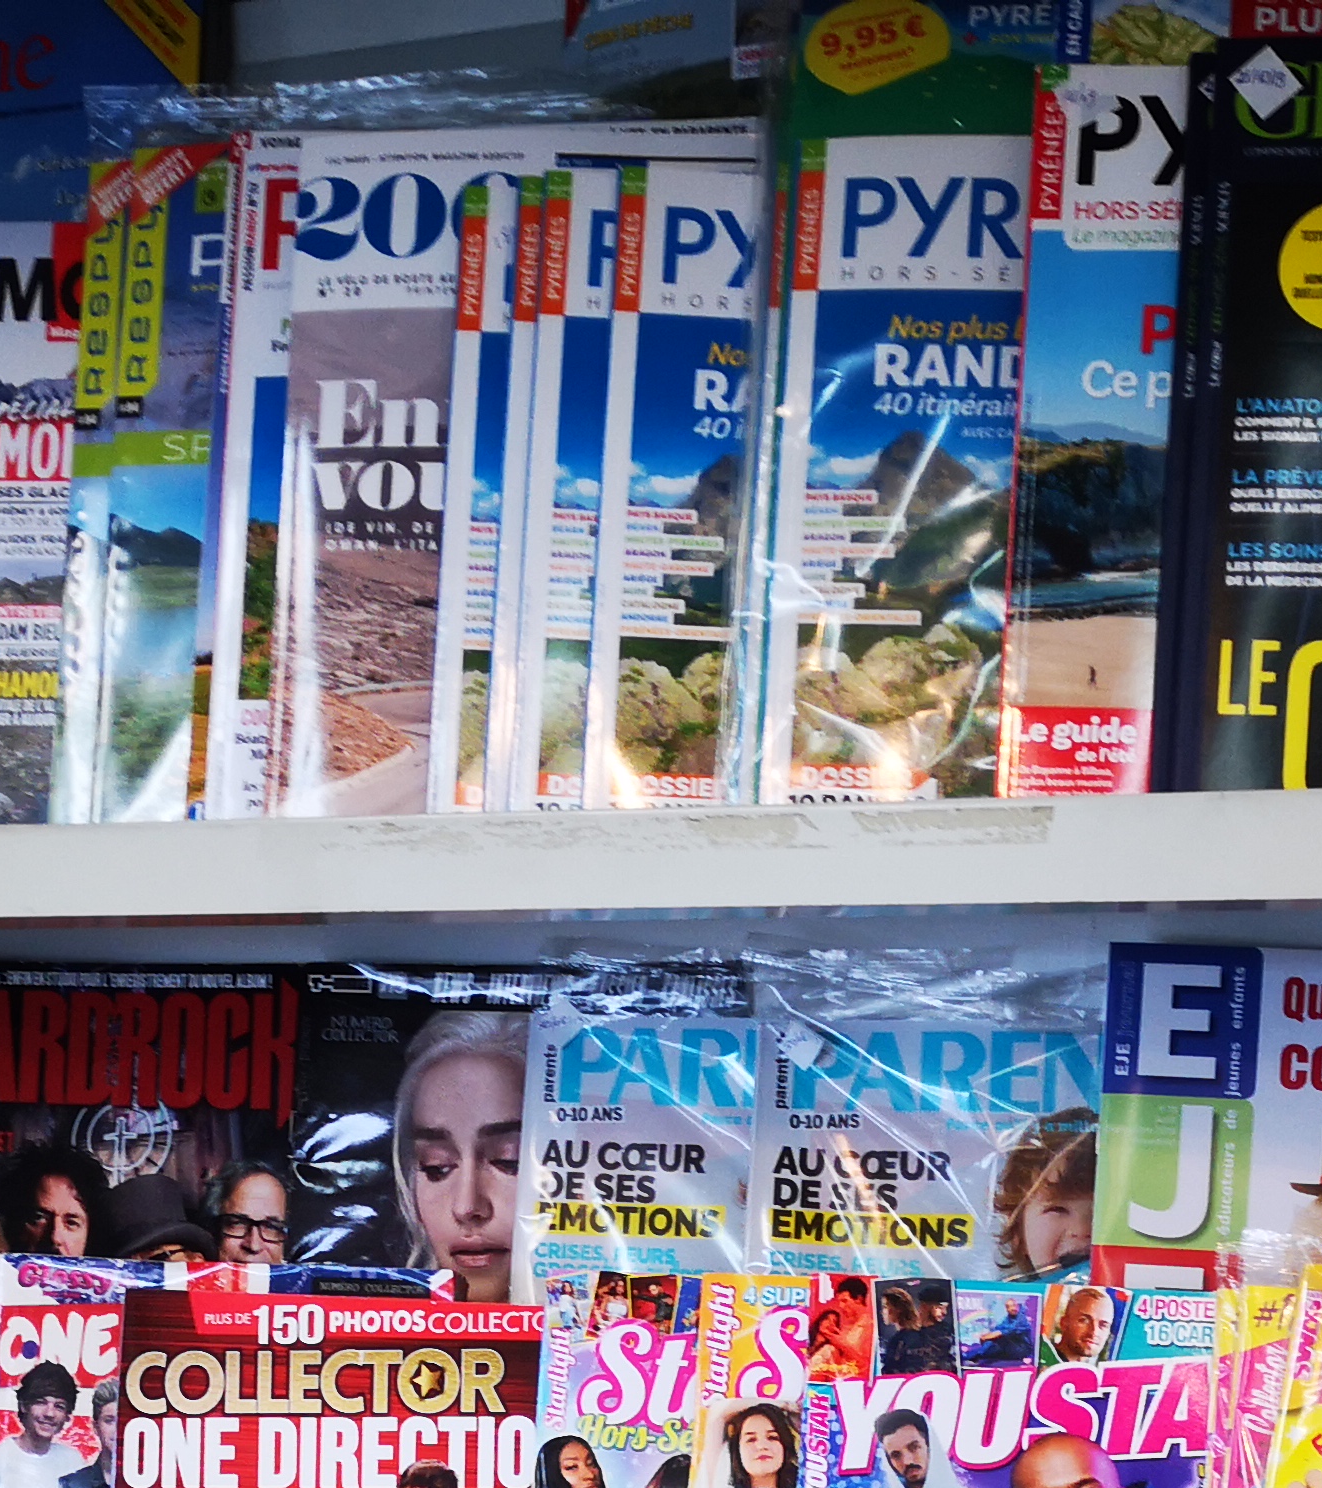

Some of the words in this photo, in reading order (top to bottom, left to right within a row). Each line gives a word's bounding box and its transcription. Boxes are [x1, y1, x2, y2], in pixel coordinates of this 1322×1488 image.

[818, 16, 897, 60] 9,95
[1038, 98, 1064, 213] PYRÉNÉES
[889, 313, 942, 341] Nos
[948, 315, 1008, 355] plus
[1228, 543, 1264, 559] LES
[1217, 638, 1281, 716] LE
[1052, 717, 1137, 751] guide
[1075, 749, 1094, 763] de
[557, 1107, 593, 1123] 0-10
[595, 1106, 623, 1122] ANS
[774, 1145, 823, 1174] AU
[204, 1311, 231, 1326] PLUS
[235, 1312, 251, 1326] DE
[253, 1304, 325, 1346] 150
[328, 1310, 426, 1334] PHOTOS
[126, 1348, 506, 1416] COLLECTOR
